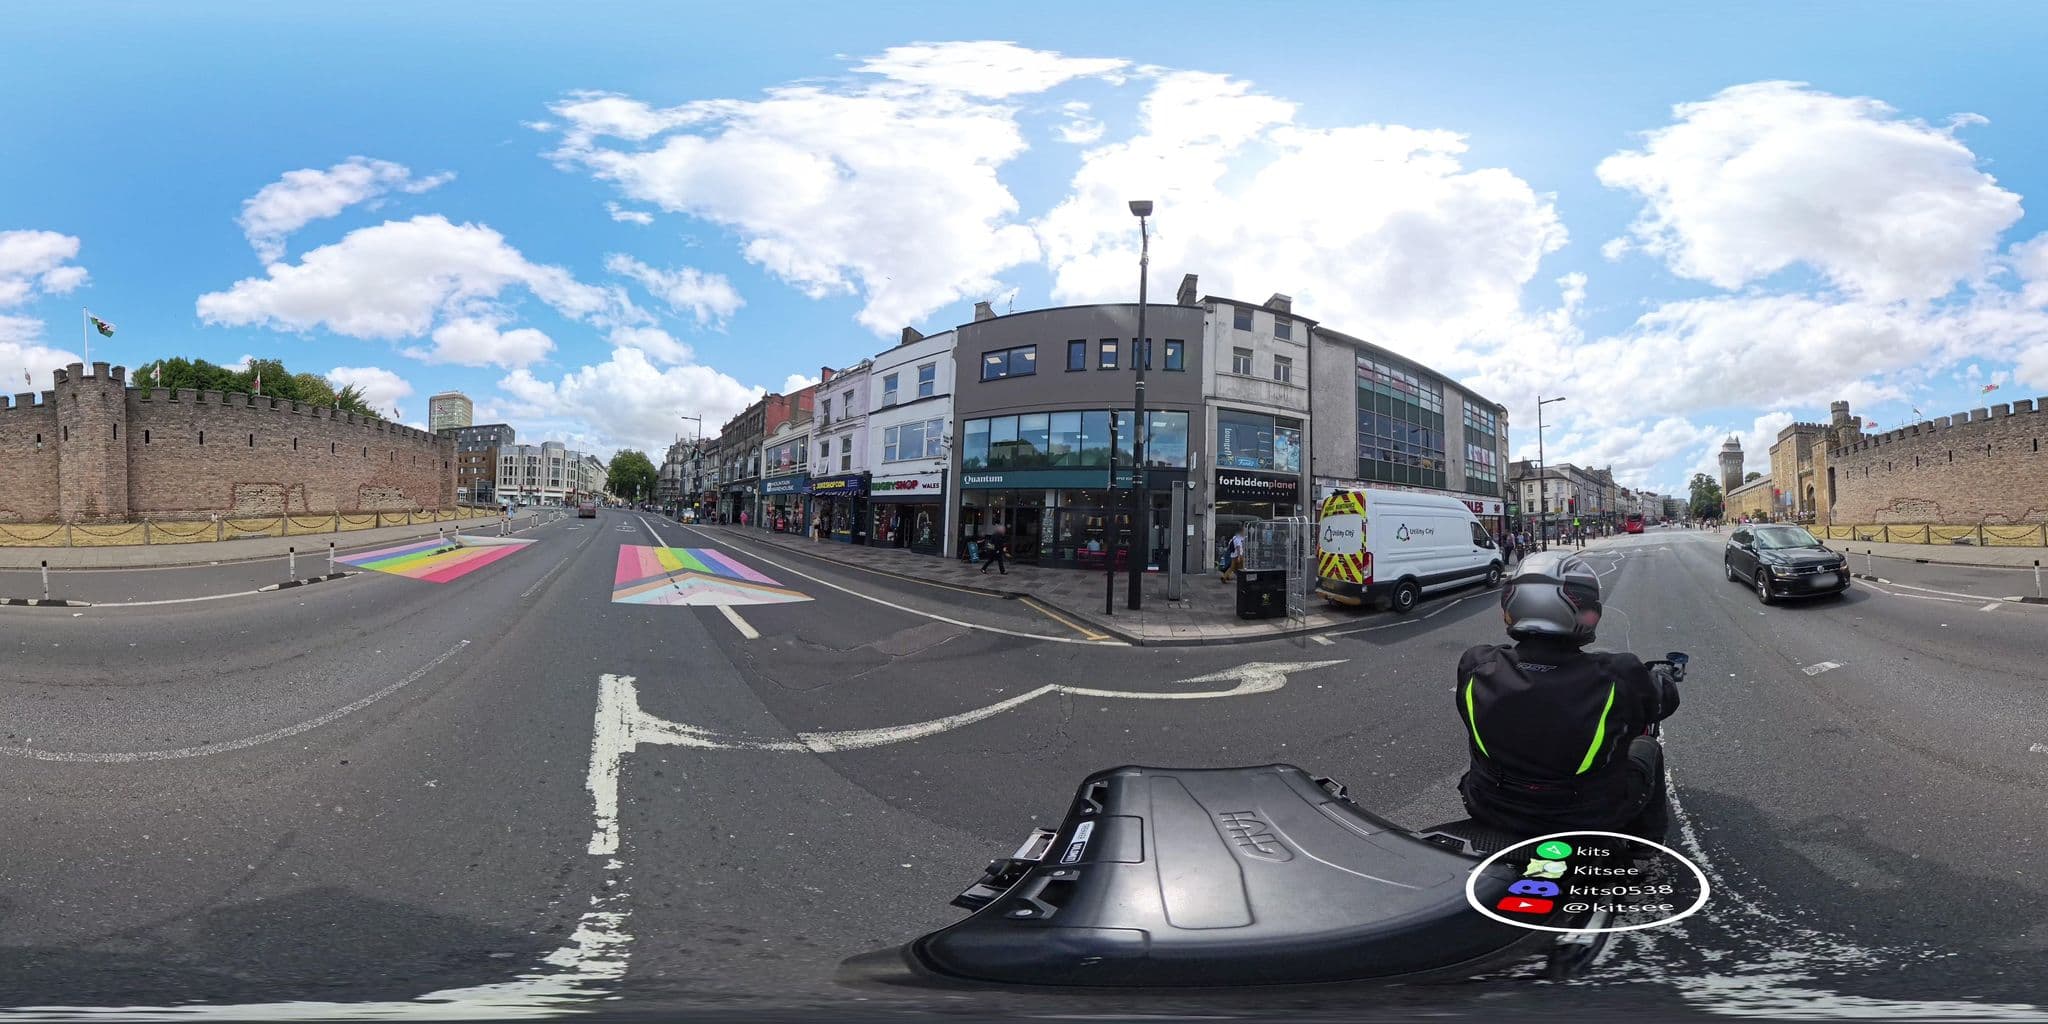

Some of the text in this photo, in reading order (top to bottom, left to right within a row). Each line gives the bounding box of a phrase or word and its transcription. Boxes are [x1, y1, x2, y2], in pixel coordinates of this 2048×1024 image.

[964, 475, 1003, 485] Quantum
[1332, 529, 1355, 538] Utility City
[1410, 528, 1434, 537] Utility City
